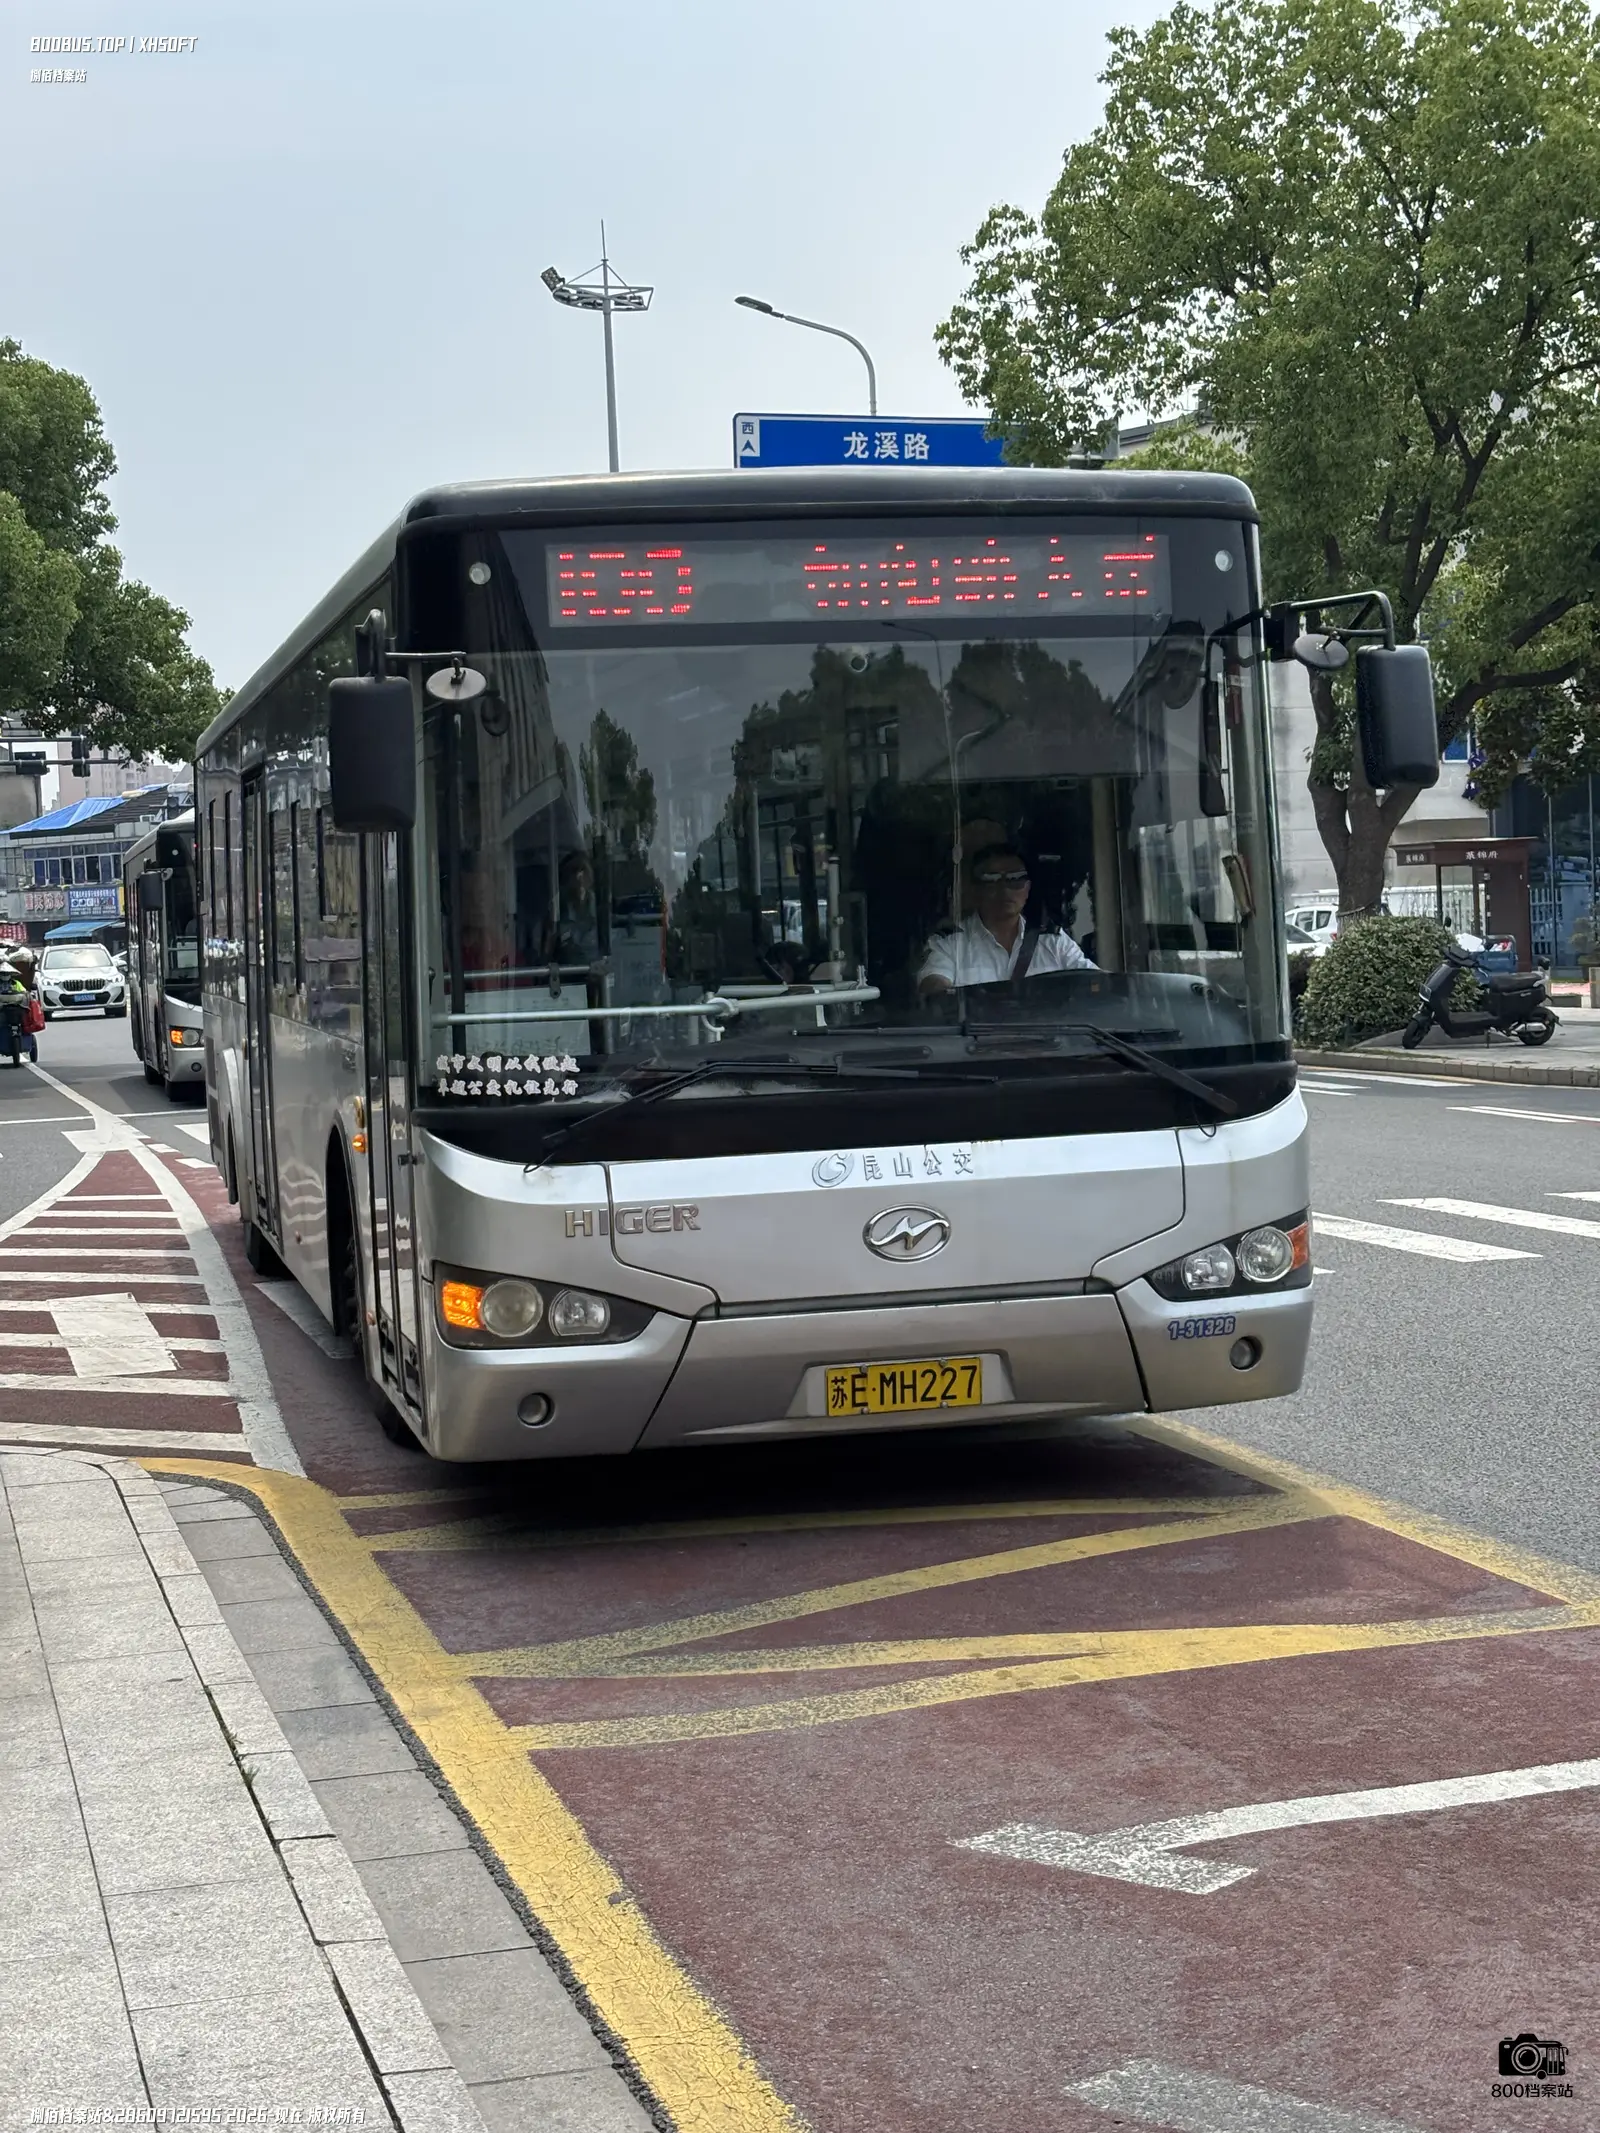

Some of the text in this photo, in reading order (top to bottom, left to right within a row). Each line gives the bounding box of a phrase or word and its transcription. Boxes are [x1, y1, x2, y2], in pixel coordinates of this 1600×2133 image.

[741, 421, 755, 435] 西
[843, 431, 930, 460] 龙溪路
[862, 1148, 974, 1181] 昆山公交
[564, 1203, 701, 1238] HIGER
[1167, 1315, 1236, 1340] 1-31326
